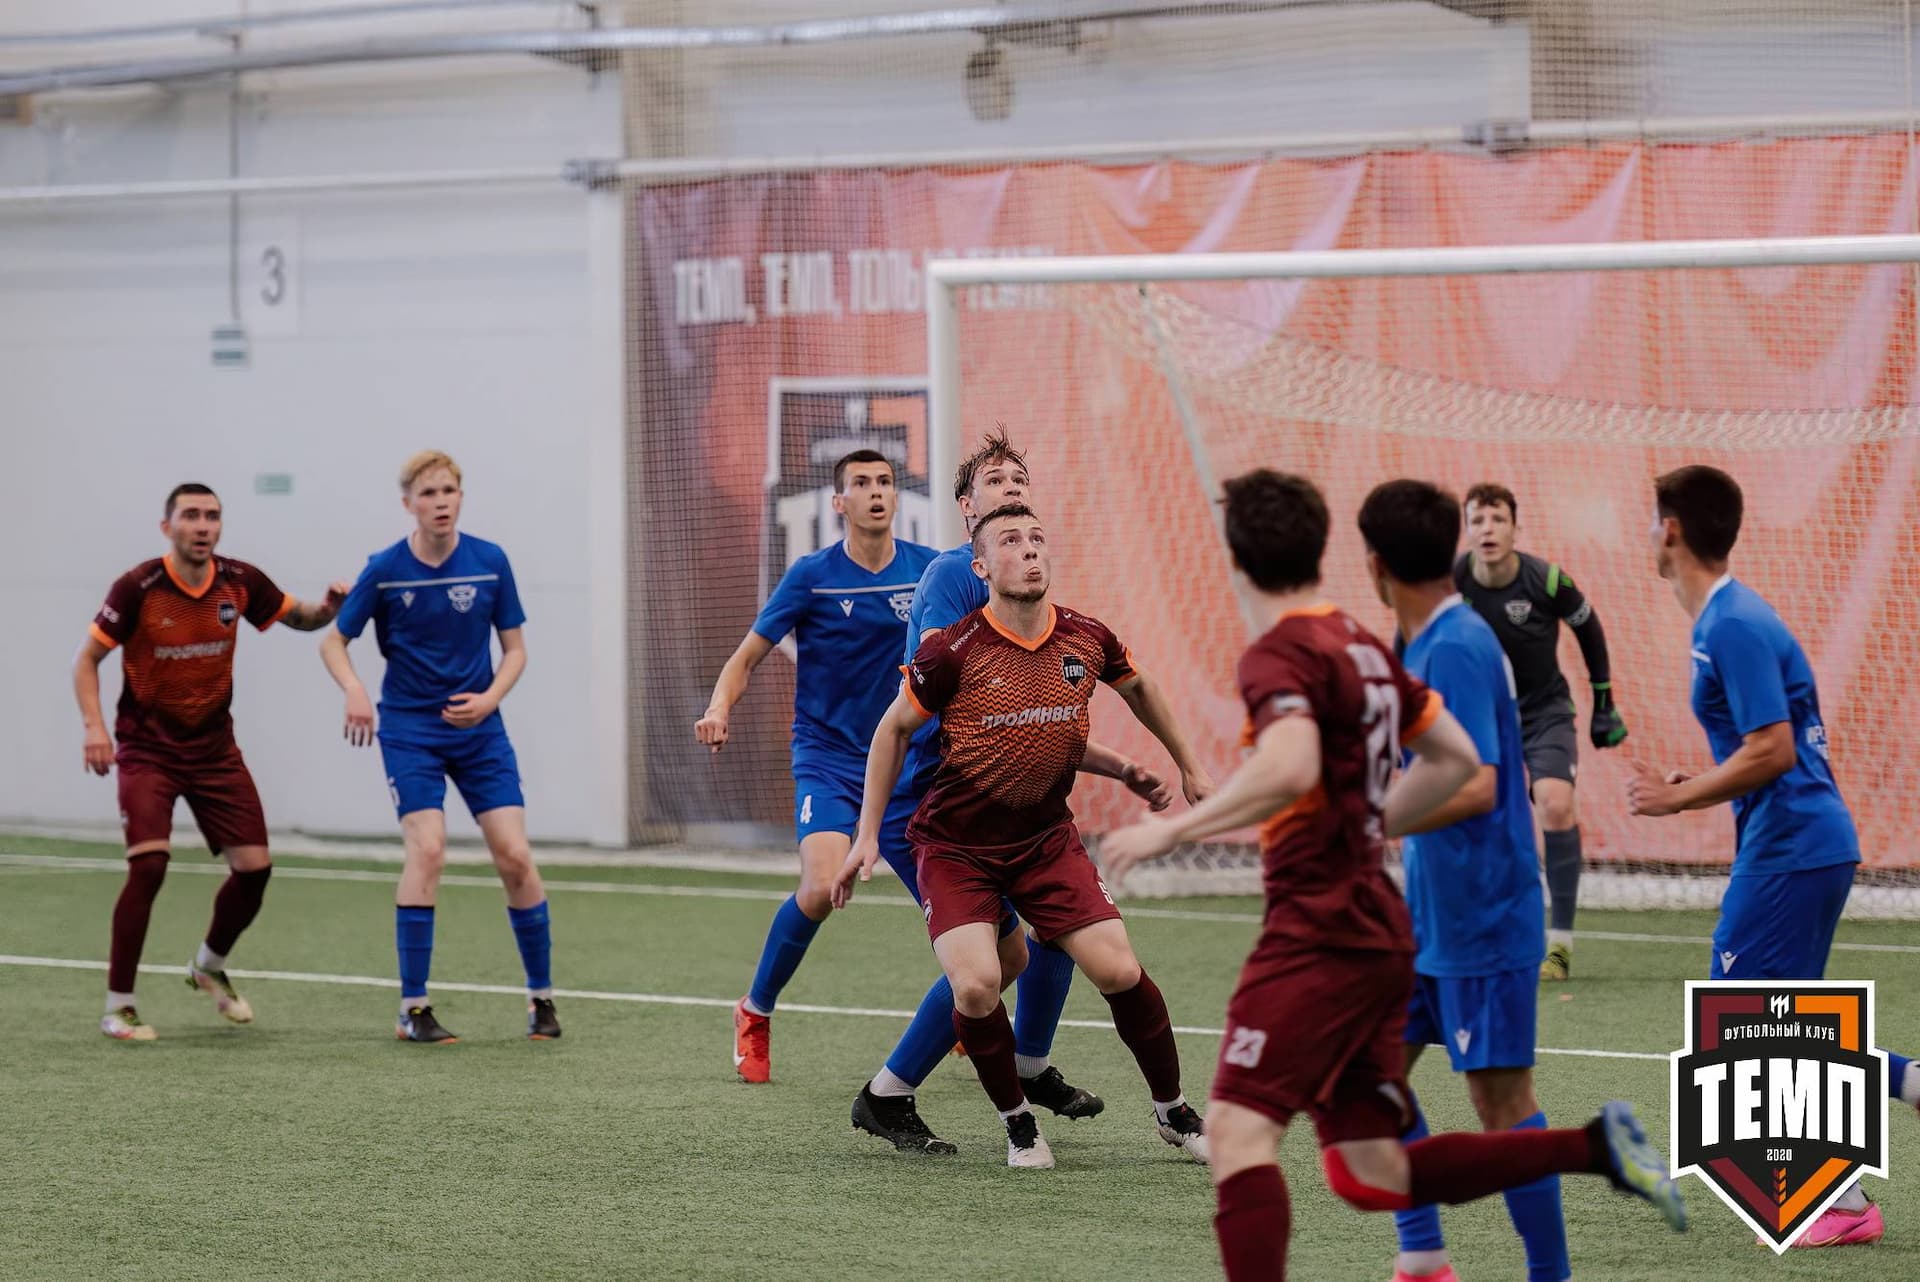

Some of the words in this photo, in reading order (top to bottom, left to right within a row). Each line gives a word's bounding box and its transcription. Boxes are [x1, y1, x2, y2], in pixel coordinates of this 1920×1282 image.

[260, 246, 287, 306] 3
[800, 795, 812, 825] 4
[1225, 1026, 1267, 1068] 23
